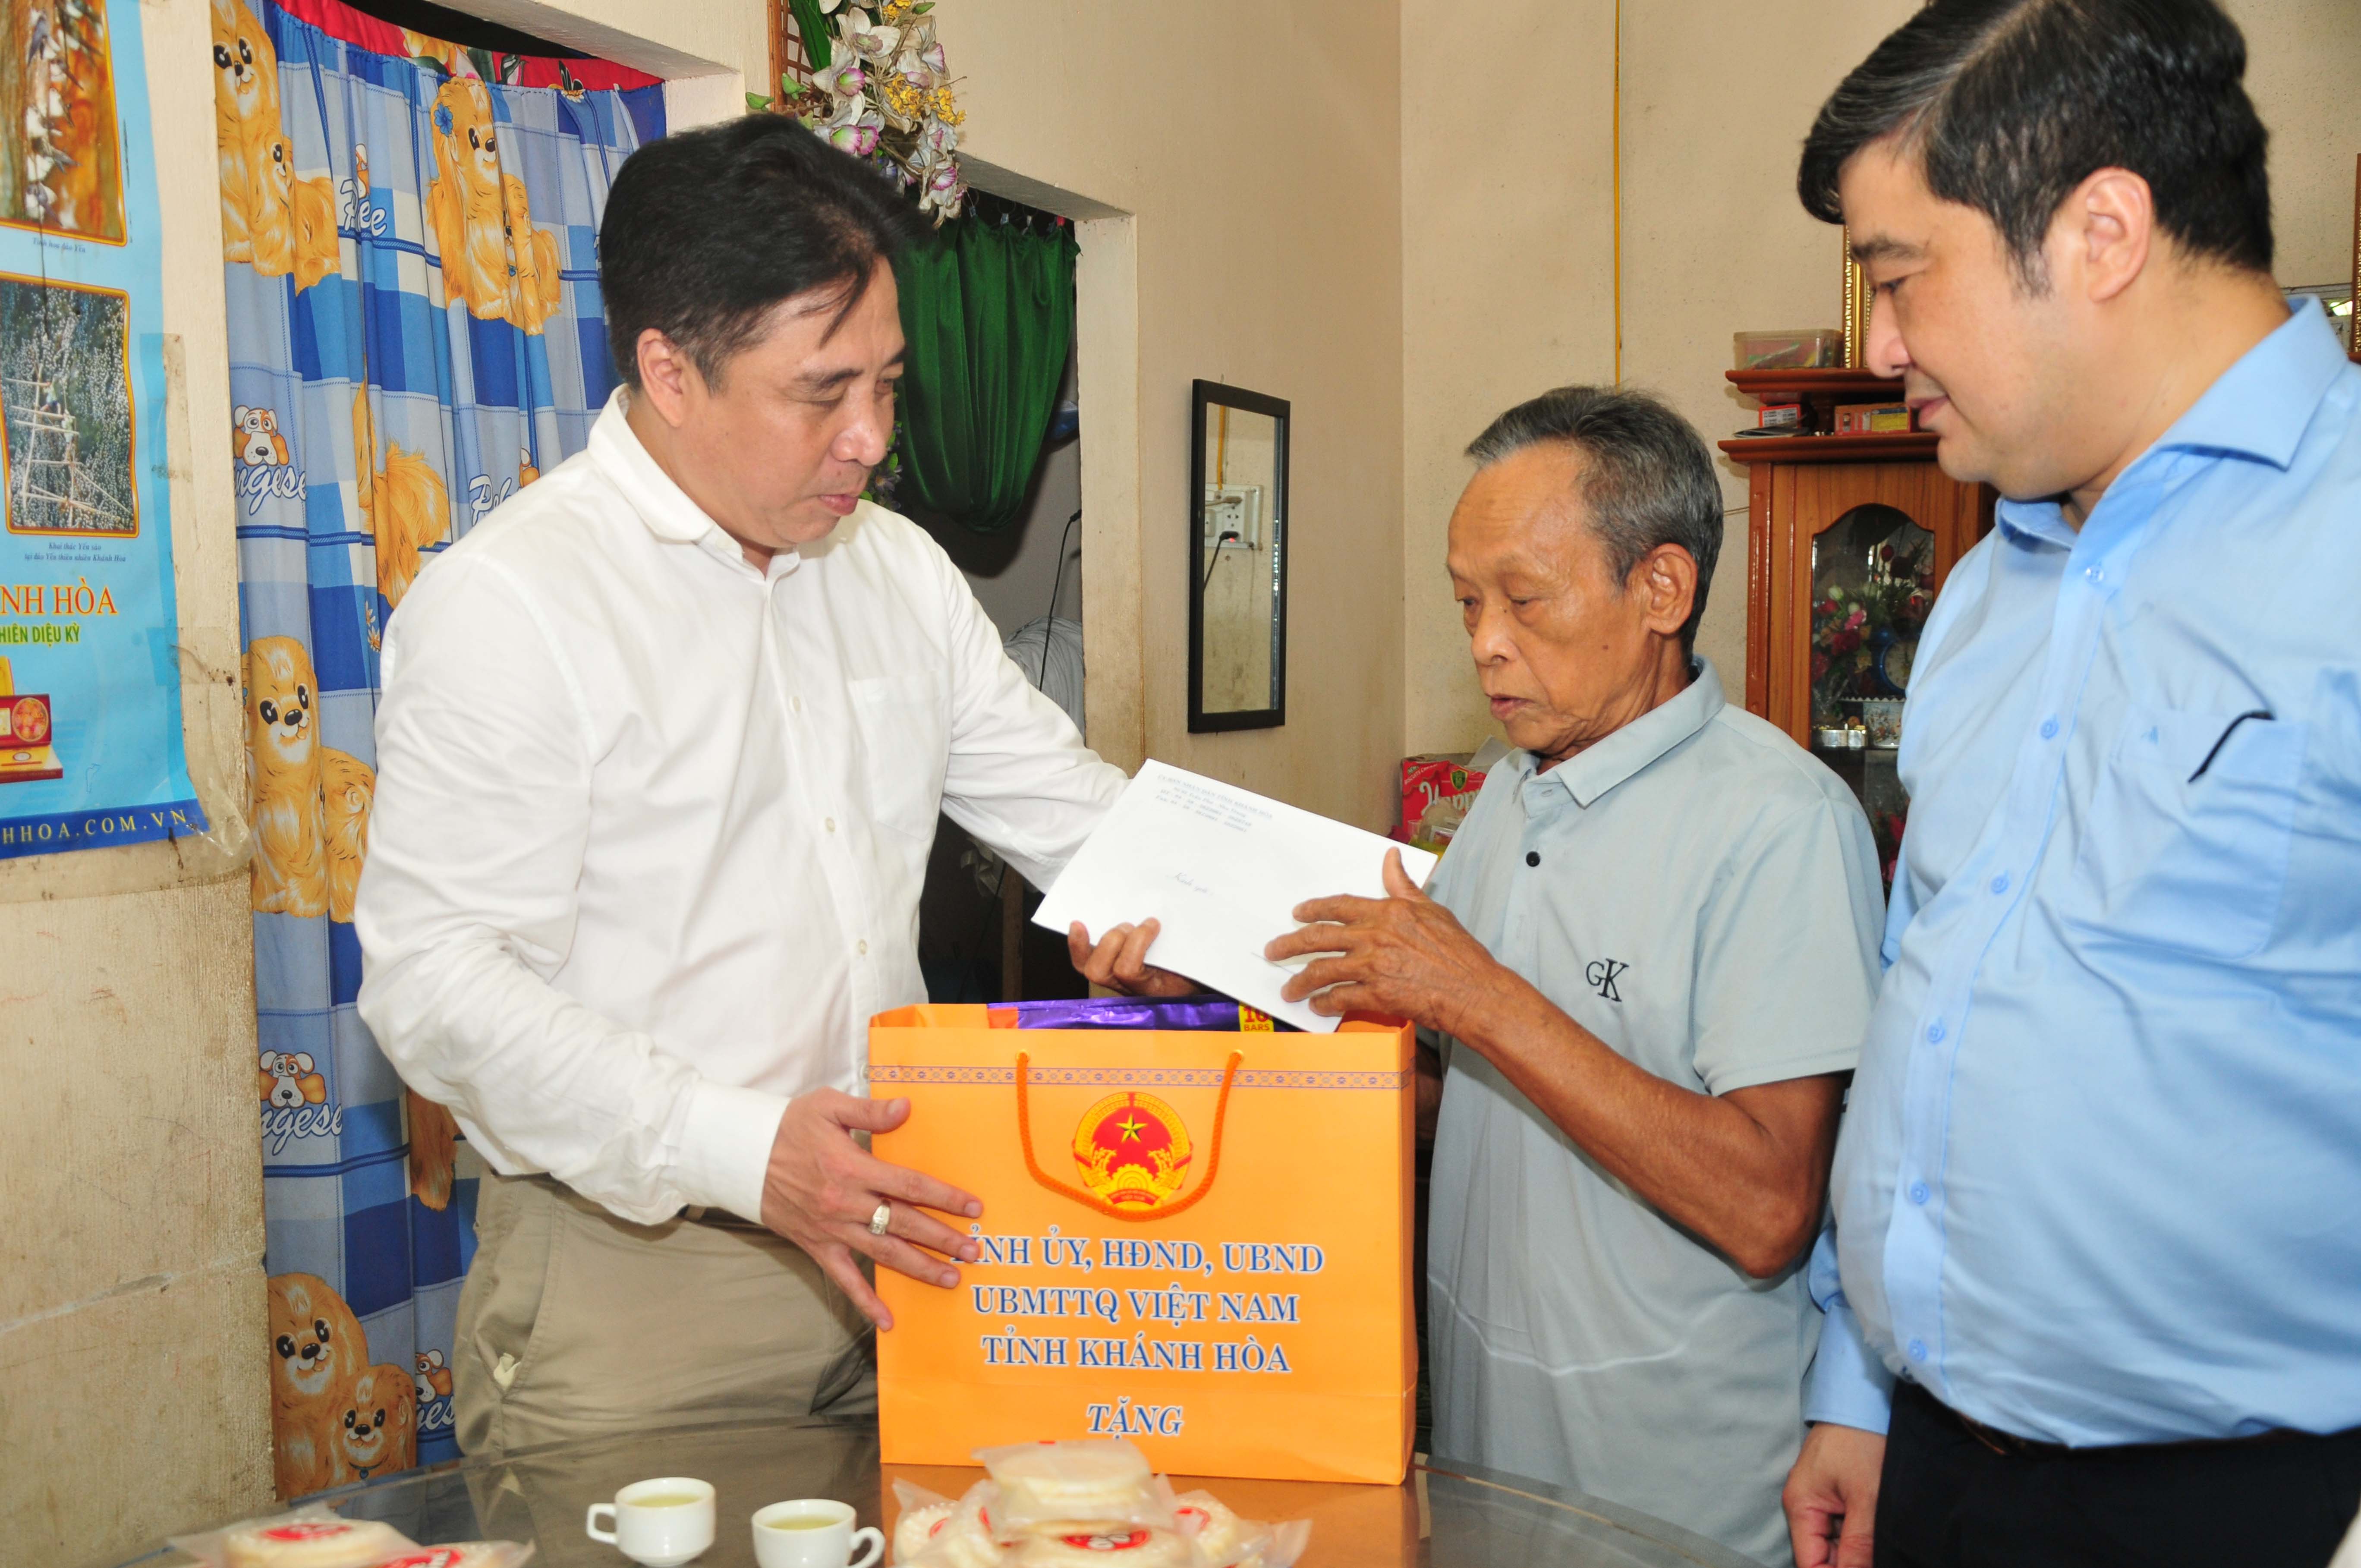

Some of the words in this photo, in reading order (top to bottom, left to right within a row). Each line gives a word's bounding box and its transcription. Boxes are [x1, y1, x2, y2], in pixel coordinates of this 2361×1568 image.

[52, 576, 119, 616] HÒA
[32, 622, 62, 648] DIỆU
[65, 622, 80, 643] KỲ
[1586, 958, 1629, 1002] GK
[1244, 1023, 1270, 1032] BARS
[1102, 1240, 1213, 1276] HĐND,
[1222, 1243, 1325, 1273] UBND
[972, 1286, 1118, 1324] UBMTTQ
[1127, 1283, 1210, 1327] VIỆT
[1220, 1294, 1298, 1322] NAM
[982, 1326, 1067, 1366] TỈNH
[1079, 1332, 1203, 1371] KHÁNH
[1214, 1335, 1291, 1373] HÒA
[1088, 1397, 1183, 1440] TẶNG
